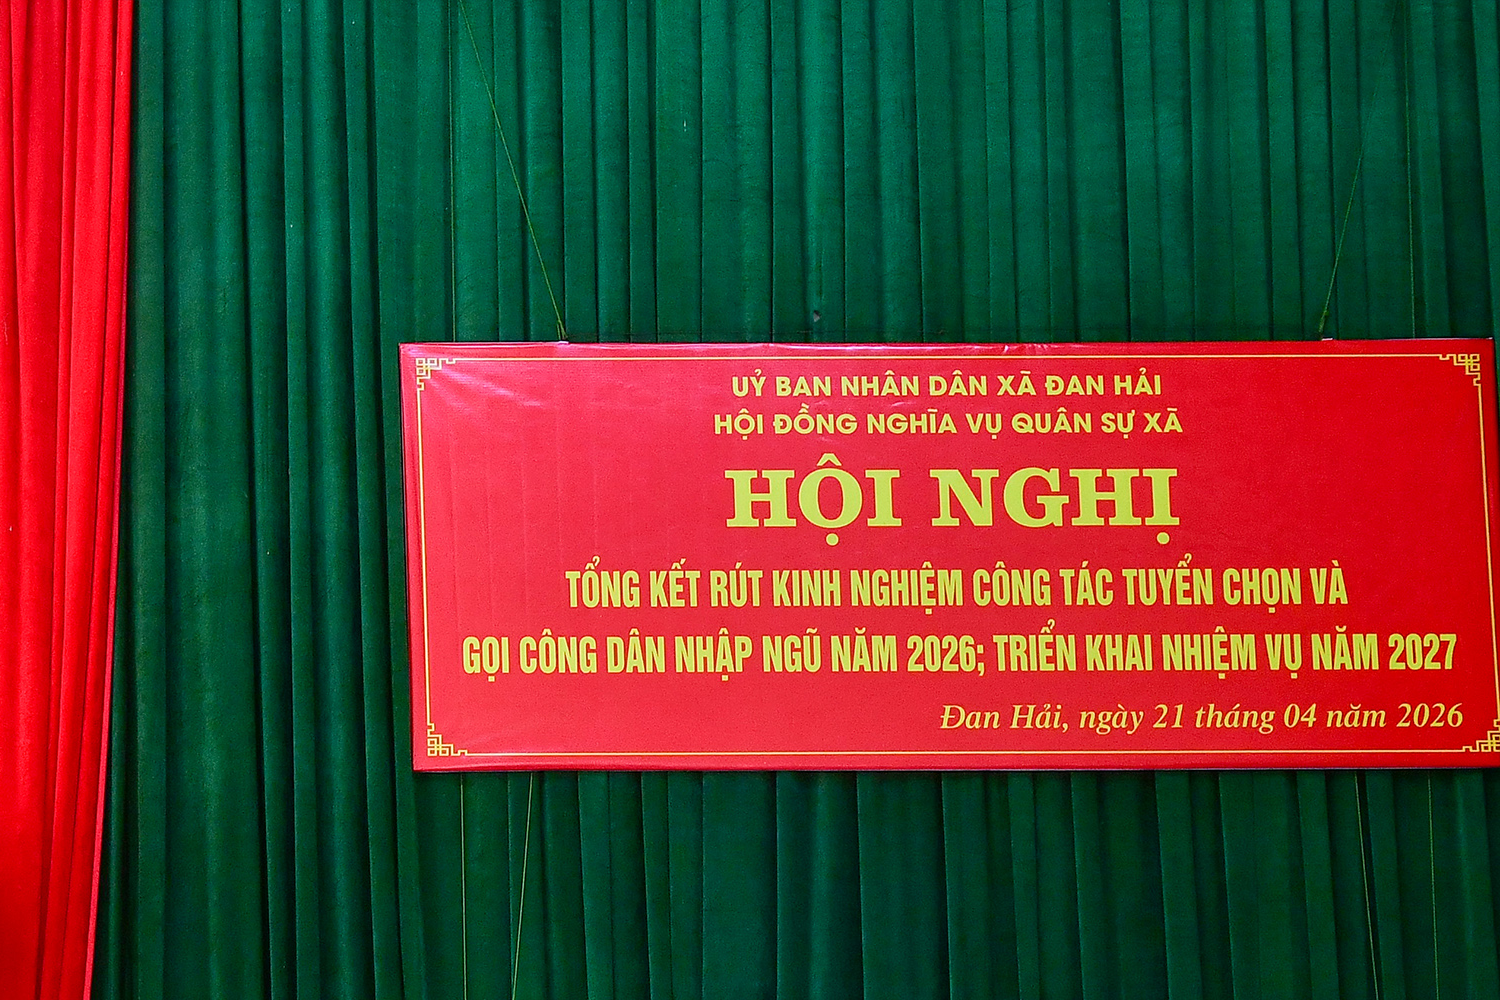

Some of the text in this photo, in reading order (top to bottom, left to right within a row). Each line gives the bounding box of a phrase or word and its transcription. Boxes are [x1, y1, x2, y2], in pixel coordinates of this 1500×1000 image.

[731, 367, 1161, 397] UỶ BAN NHÂN DÂN XÃ ĐAN HẢI
[714, 403, 1184, 441] HỘI ĐỒNG NGHĨA VỤ QUÂN SỰ XÃ
[725, 453, 1180, 546] HỘI NGHỊ
[564, 552, 1349, 615] TỔNG KẾT RÚT KINH NGHIỆM CÔNG TÁC TUYỂN CHỌN VÀ
[462, 618, 1457, 683] GỌI CÔNG DÂN NHẬP NGŨ NĂM 2026; TRIỂN KHAI NHIỆM VỤ NĂM 2027
[939, 702, 1463, 736] Đan Hải, ngày 21 tháng 04 năm 2026
